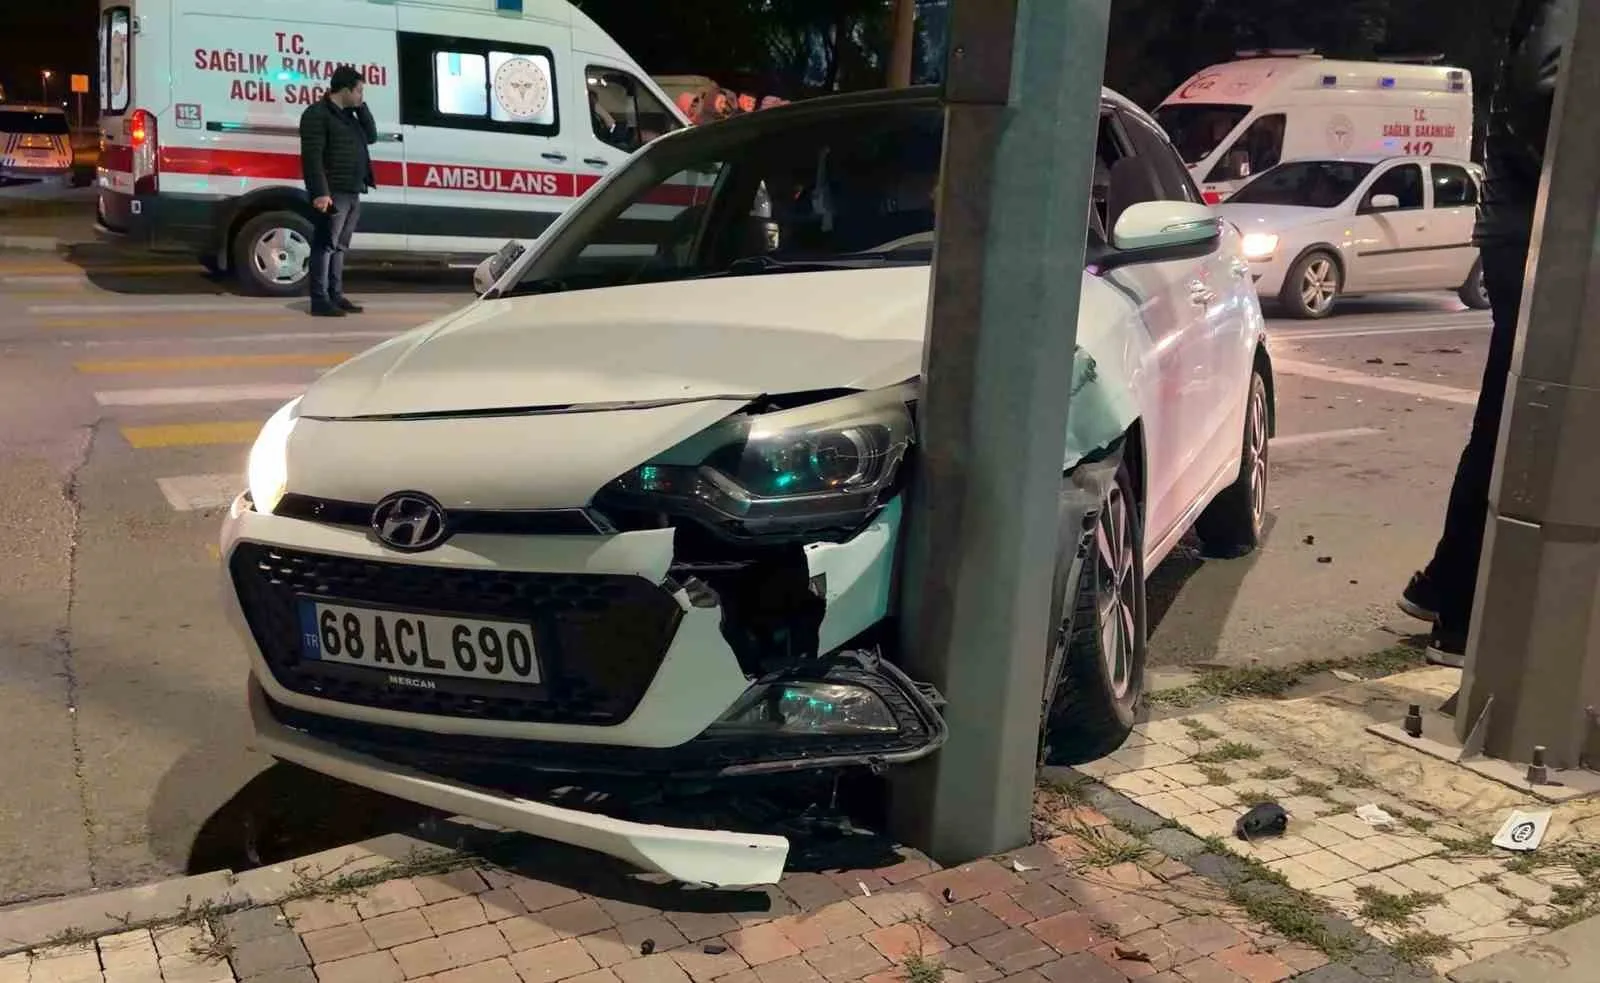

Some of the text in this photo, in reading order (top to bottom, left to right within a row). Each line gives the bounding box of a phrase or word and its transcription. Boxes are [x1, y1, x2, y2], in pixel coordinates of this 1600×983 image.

[275, 32, 310, 55] T.C.
[195, 48, 269, 75] SAĞLIK
[230, 79, 276, 103] ACİL
[178, 105, 198, 119] 112
[1403, 141, 1433, 156] 112
[424, 166, 558, 194] AMBULANS
[304, 608, 532, 677] TR 68 ACL 690
[388, 674, 437, 690] MERCAN
